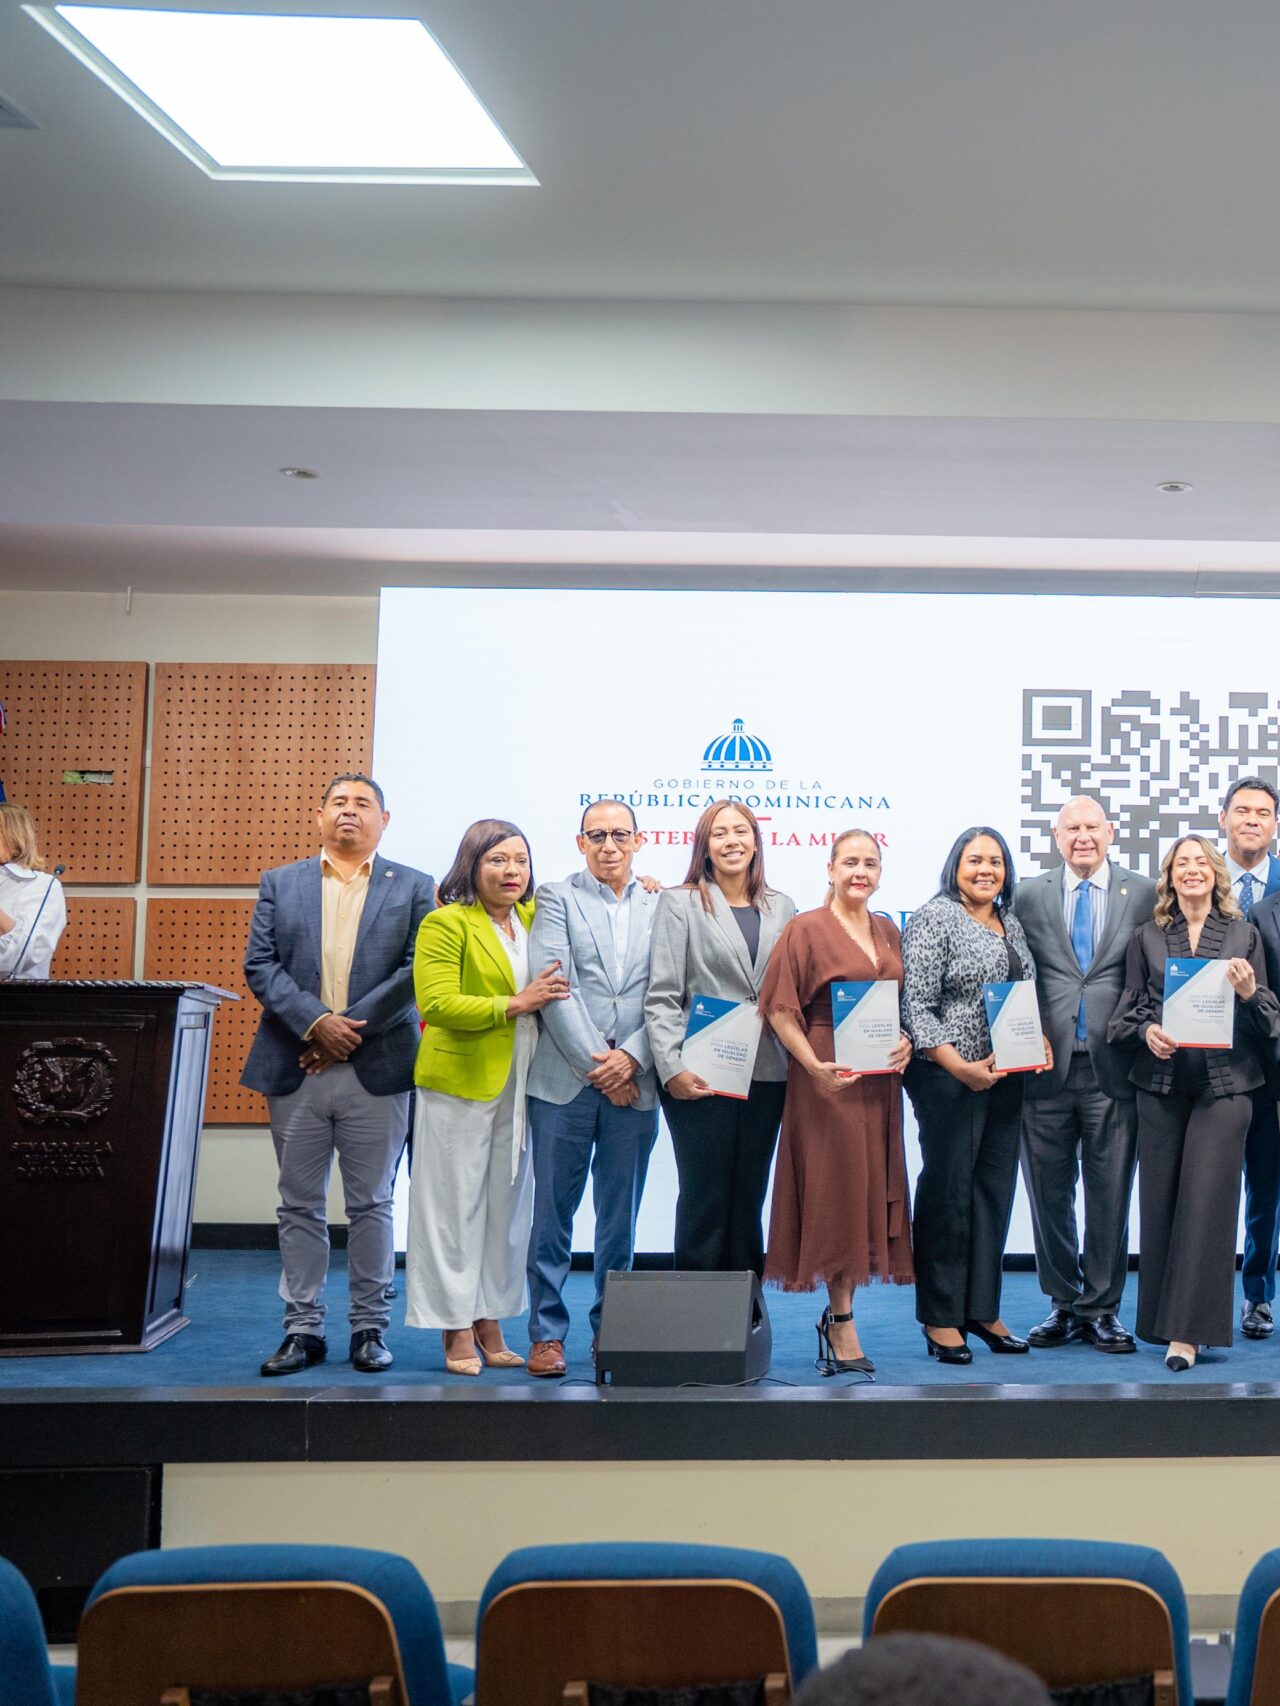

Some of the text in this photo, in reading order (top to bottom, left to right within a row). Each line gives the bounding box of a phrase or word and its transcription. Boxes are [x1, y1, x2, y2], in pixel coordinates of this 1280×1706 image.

[653, 779, 822, 790] GOBIERNO DE LA
[771, 832, 800, 846] LA
[722, 1049, 747, 1057] IGUALDAD
